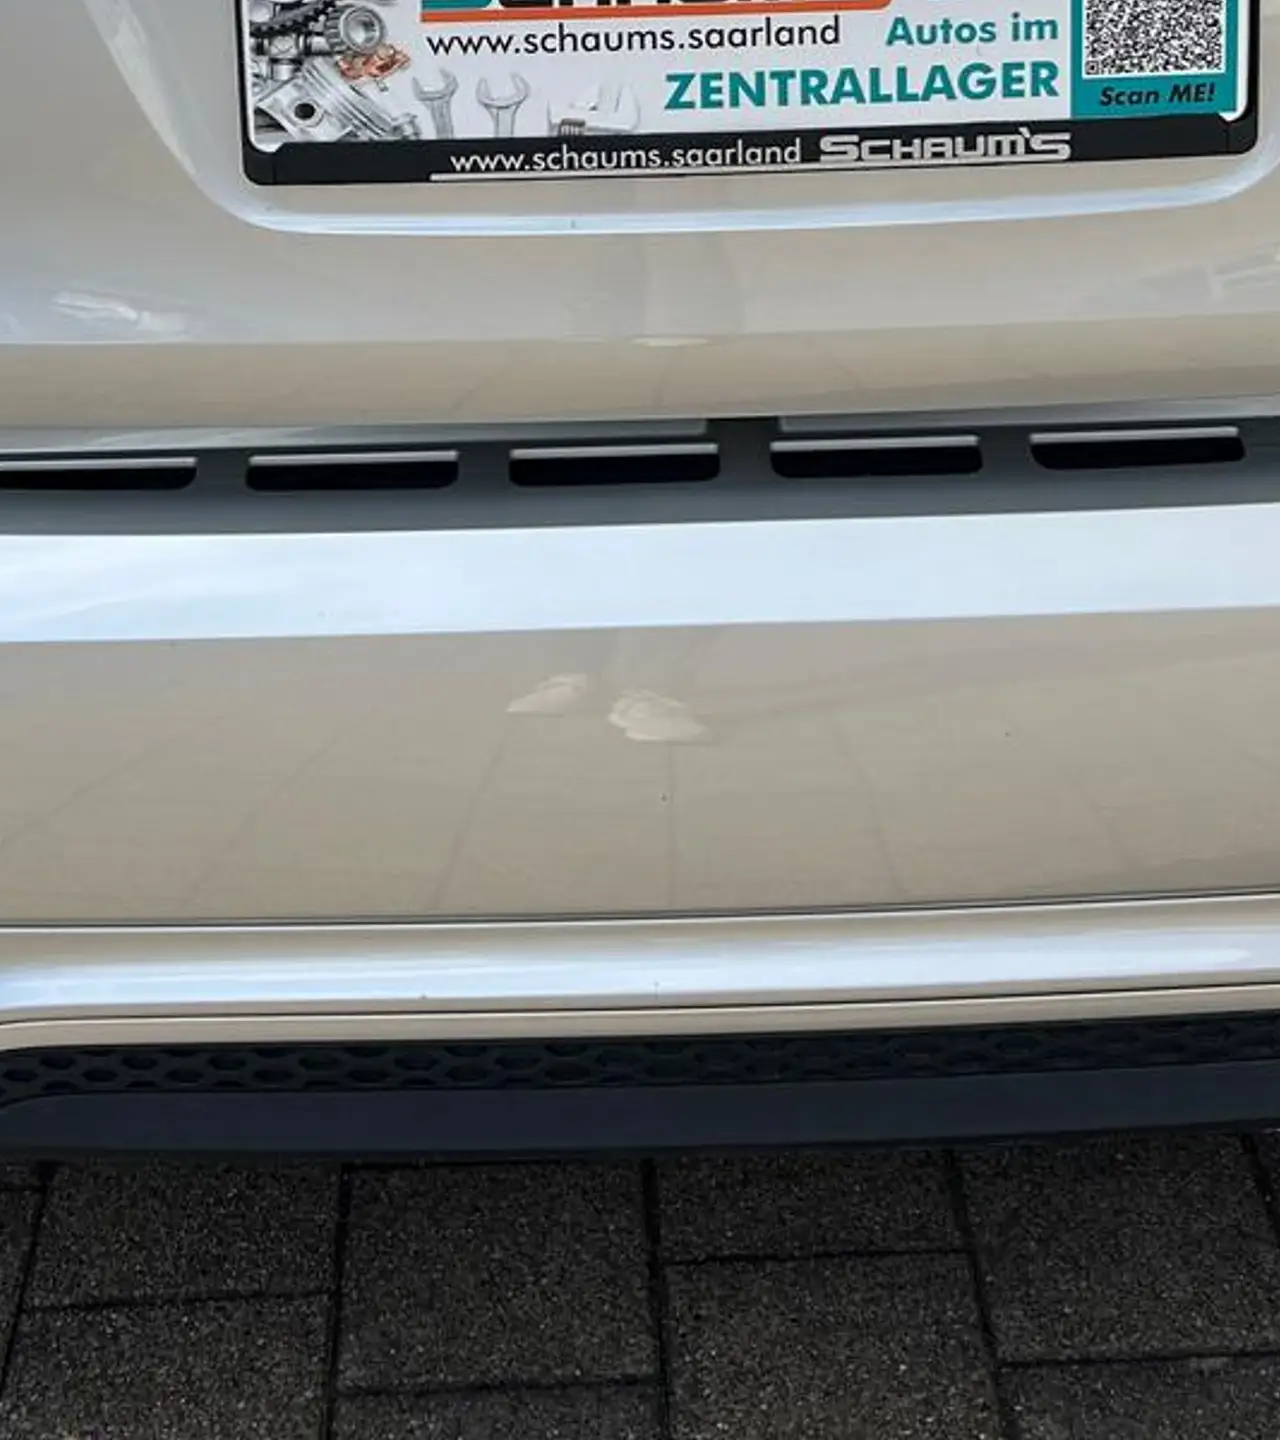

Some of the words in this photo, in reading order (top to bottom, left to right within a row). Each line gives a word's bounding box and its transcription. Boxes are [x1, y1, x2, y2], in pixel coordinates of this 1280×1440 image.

[426, 14, 840, 55] www.schaums.saarland
[886, 16, 997, 46] Autos
[1011, 11, 1059, 41] im
[664, 60, 1060, 110] ZENTRALLAGER
[1100, 86, 1160, 106] Scan
[1168, 82, 1216, 103] ME!
[450, 137, 802, 172] www.schaums.saarland
